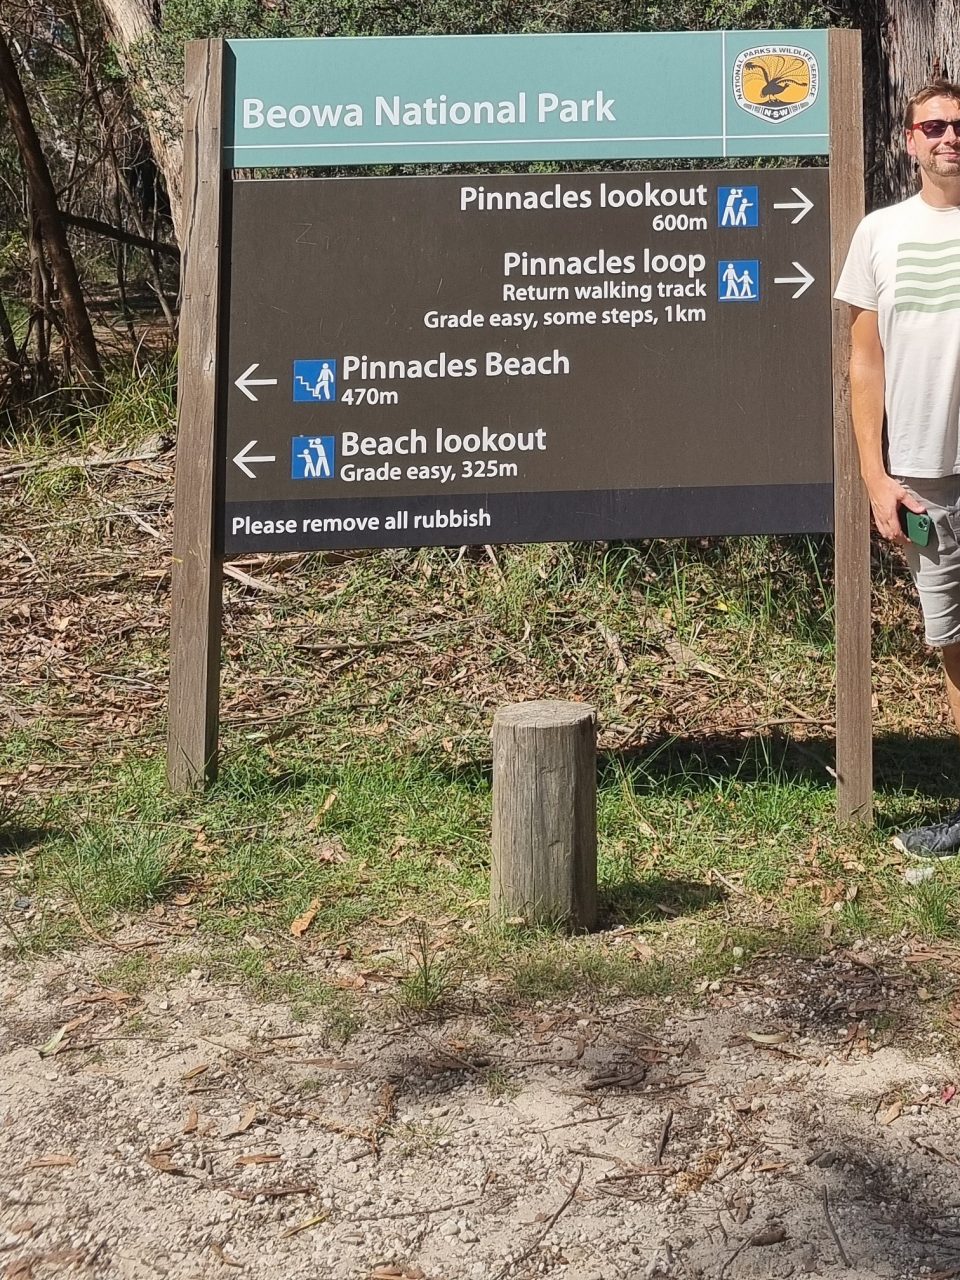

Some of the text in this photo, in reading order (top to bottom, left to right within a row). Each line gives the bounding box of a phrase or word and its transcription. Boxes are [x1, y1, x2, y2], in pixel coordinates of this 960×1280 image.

[734, 60, 744, 100] NATIONAL
[743, 48, 771, 58] PARKS
[778, 48, 814, 62] WILDLIFE
[809, 63, 817, 98] SERVICE
[243, 91, 616, 128] Beowa National Park
[460, 182, 708, 210] Pinnacles lookout
[653, 215, 708, 231] 600m
[504, 248, 706, 277] Pinnacles loop
[503, 279, 707, 302] Return walking track
[424, 305, 706, 330] Grade easy, some steps, 1km
[344, 349, 570, 380] Pinnacles Beach
[341, 388, 399, 405] 470m
[342, 427, 547, 456] Beach lookout
[340, 460, 518, 483] Grade easy, 325m
[233, 508, 491, 534] Please remove all rubbish
